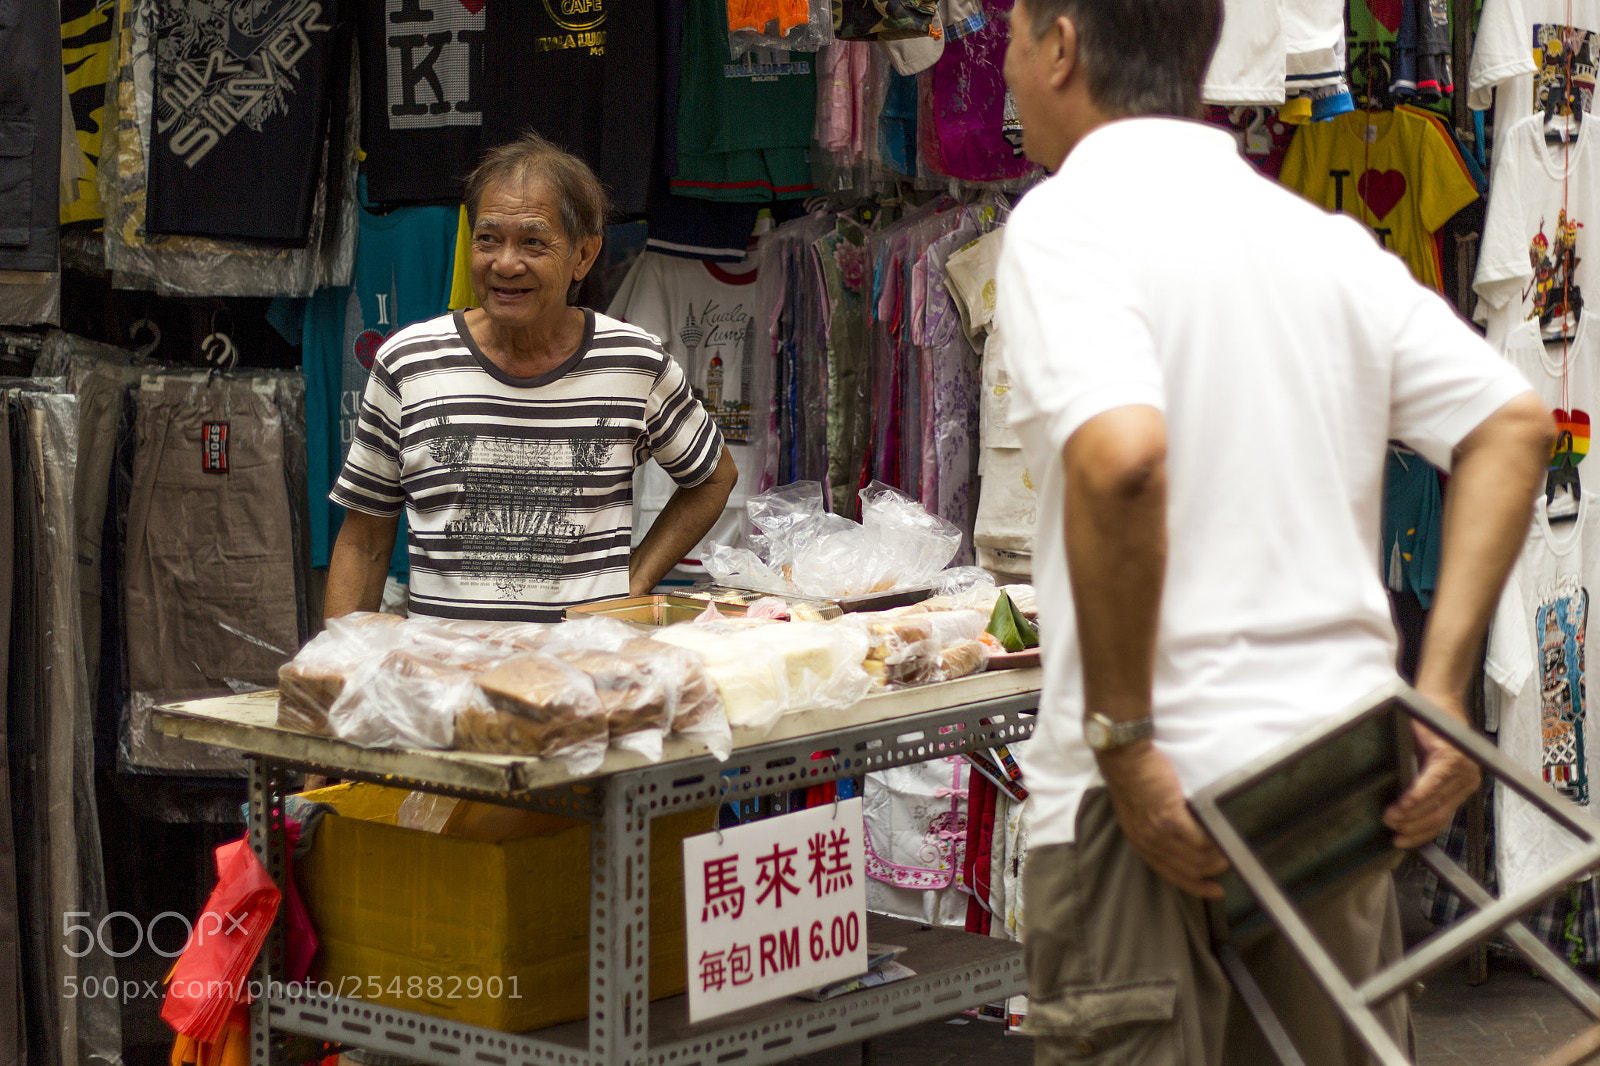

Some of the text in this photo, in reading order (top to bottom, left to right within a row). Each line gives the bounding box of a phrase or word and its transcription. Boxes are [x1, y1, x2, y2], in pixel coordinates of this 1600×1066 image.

[700, 298, 748, 328] Kuala
[210, 425, 221, 469] SPORT
[700, 827, 854, 923] 馬來糕
[759, 926, 801, 978] RM
[809, 911, 859, 962] 6.00
